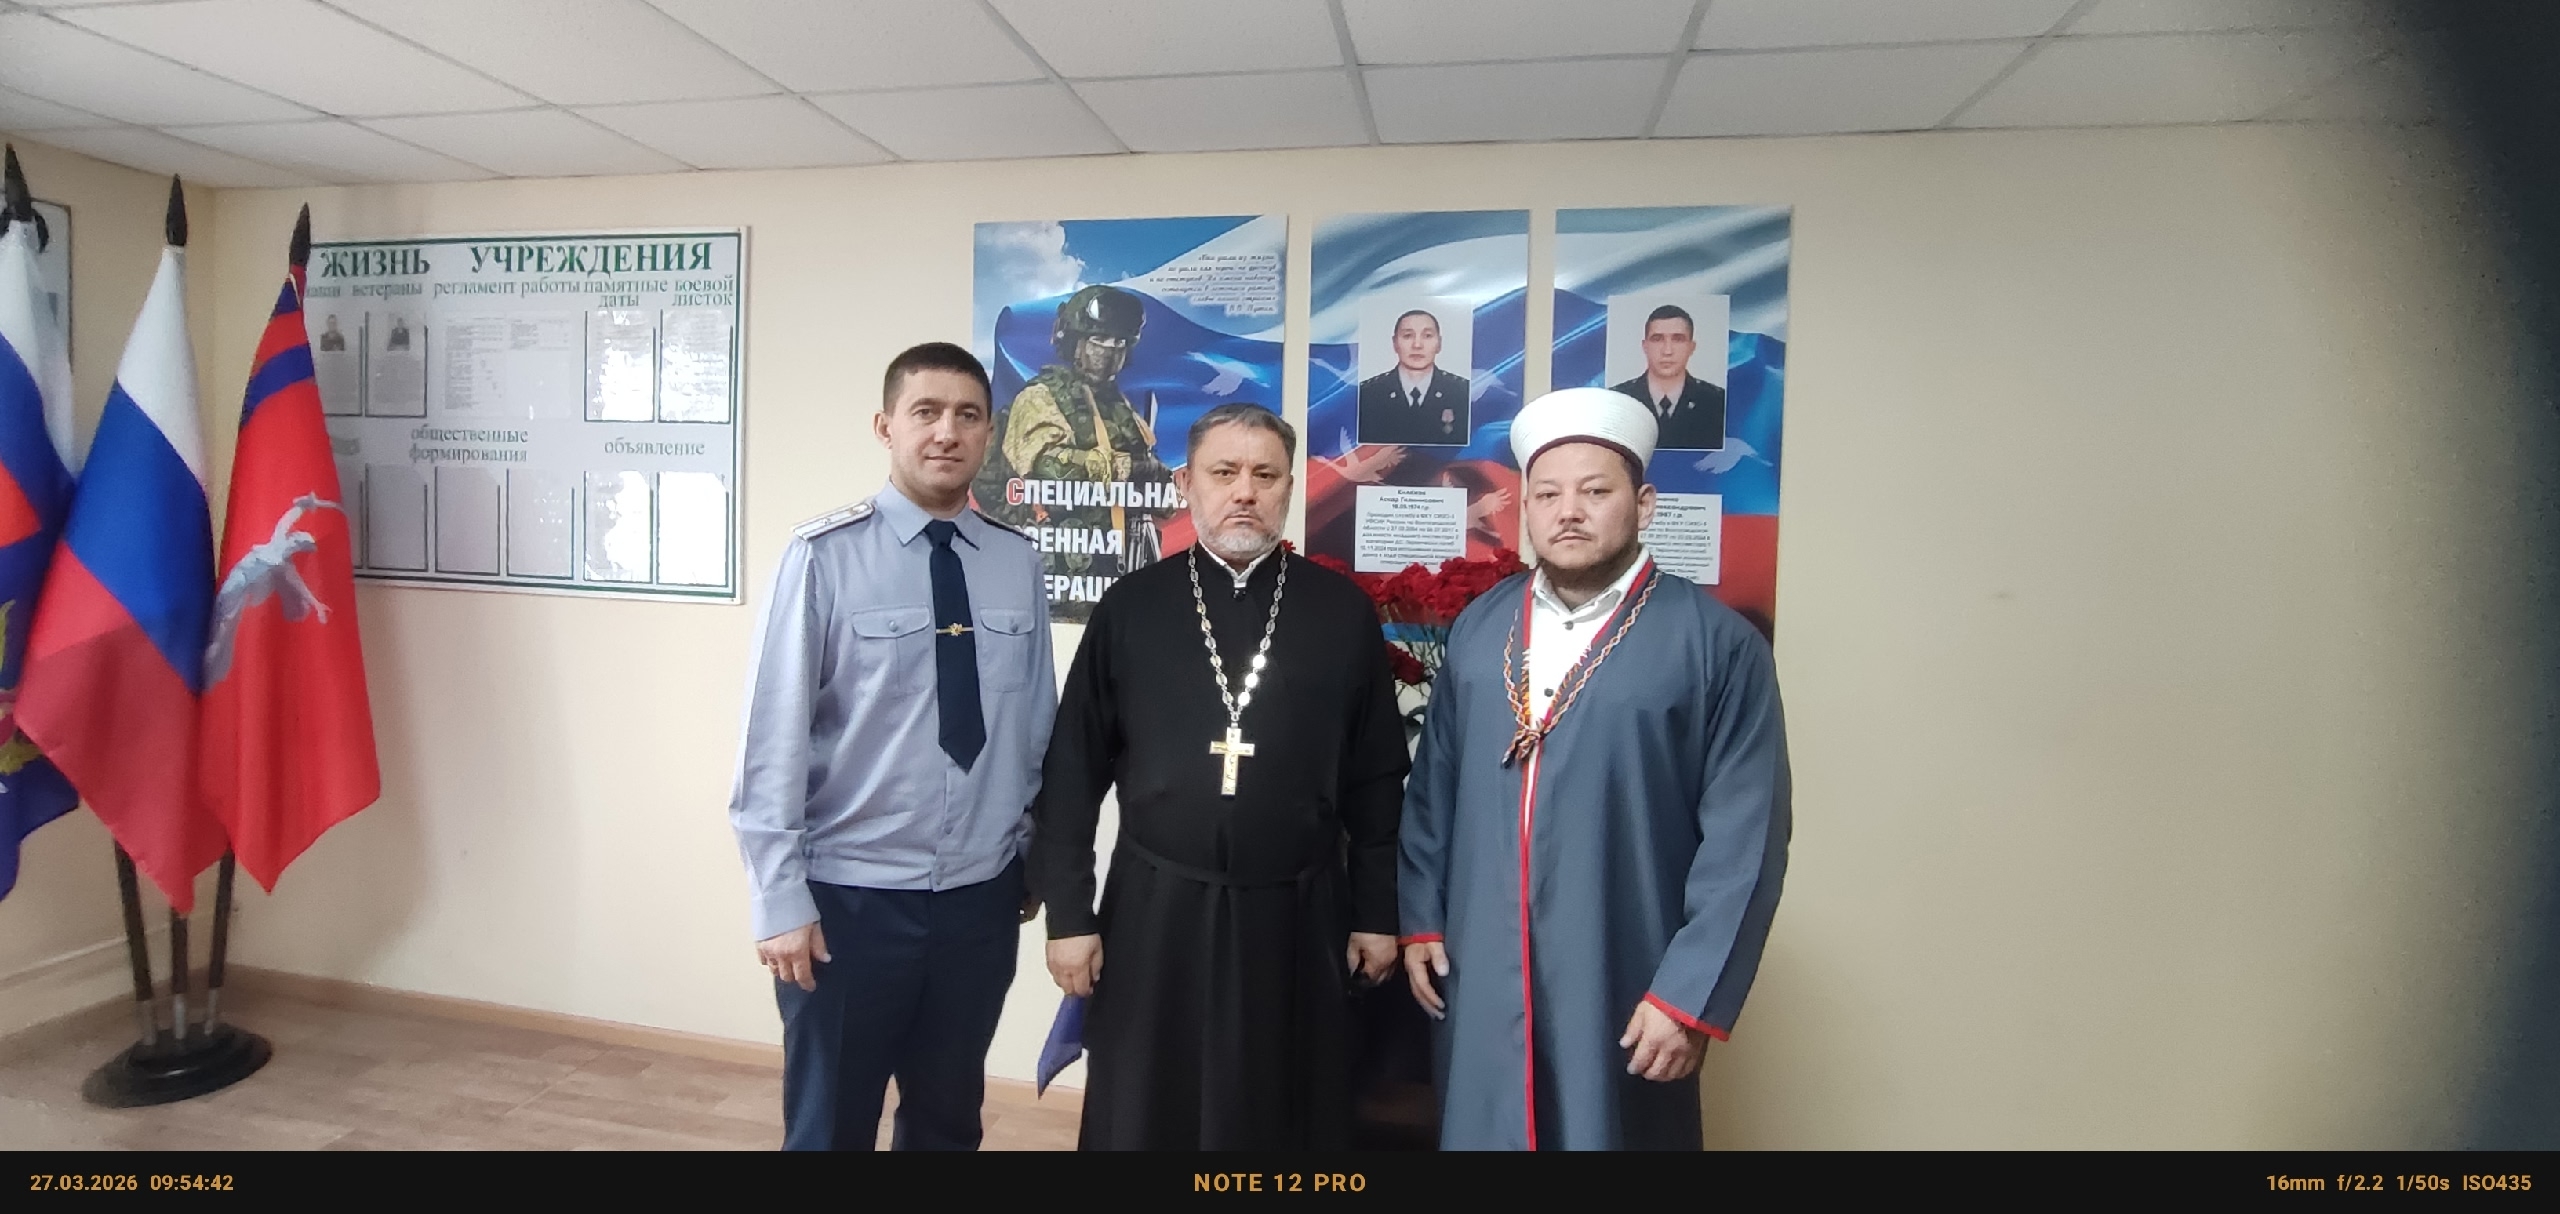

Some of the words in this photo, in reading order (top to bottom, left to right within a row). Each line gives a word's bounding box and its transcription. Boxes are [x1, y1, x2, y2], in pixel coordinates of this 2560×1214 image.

[319, 248, 431, 278] ЖИЗНЬ
[470, 242, 712, 278] УЧРЕЖДЕНИЯ
[352, 281, 422, 300] ветераны
[434, 280, 515, 298] регламент
[521, 276, 580, 298] работы
[584, 278, 668, 294] памятные
[674, 275, 734, 292] боевой
[598, 294, 640, 308] даты
[671, 292, 734, 307] листок
[411, 423, 529, 443] общественные
[409, 443, 527, 464] формирования
[604, 436, 705, 456] объявление
[1005, 477, 1188, 512] СПЕЦИАЛЬНА
[1020, 524, 1123, 555] ОЕННАЯ
